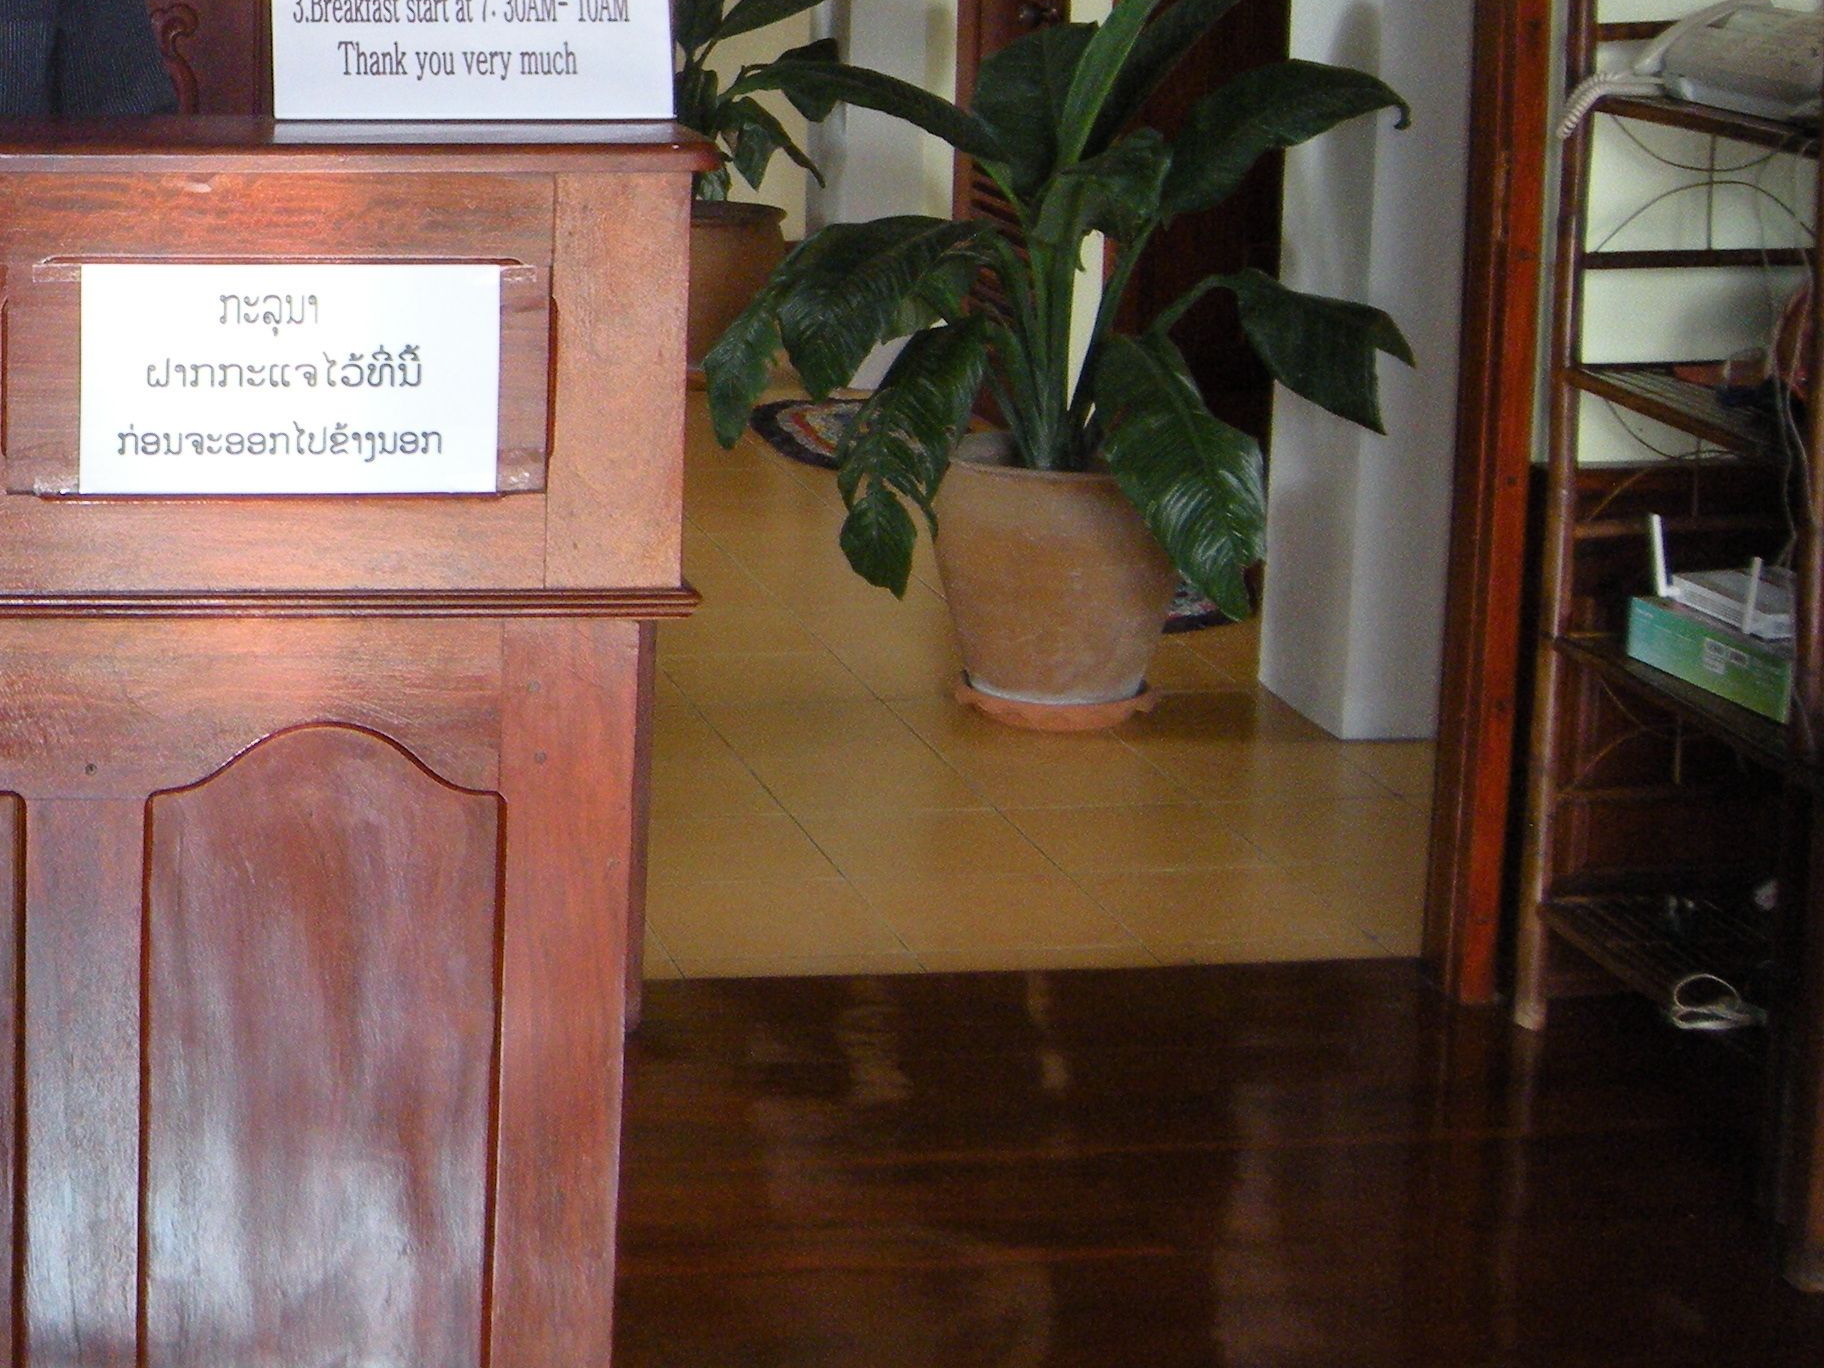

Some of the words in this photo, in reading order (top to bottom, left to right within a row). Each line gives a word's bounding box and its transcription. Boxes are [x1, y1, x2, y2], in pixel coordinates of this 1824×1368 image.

[337, 41, 408, 76] Thank
[416, 51, 455, 81] you
[463, 51, 512, 81] very
[519, 42, 578, 76] much
[219, 294, 318, 336] ກະລຸນາ
